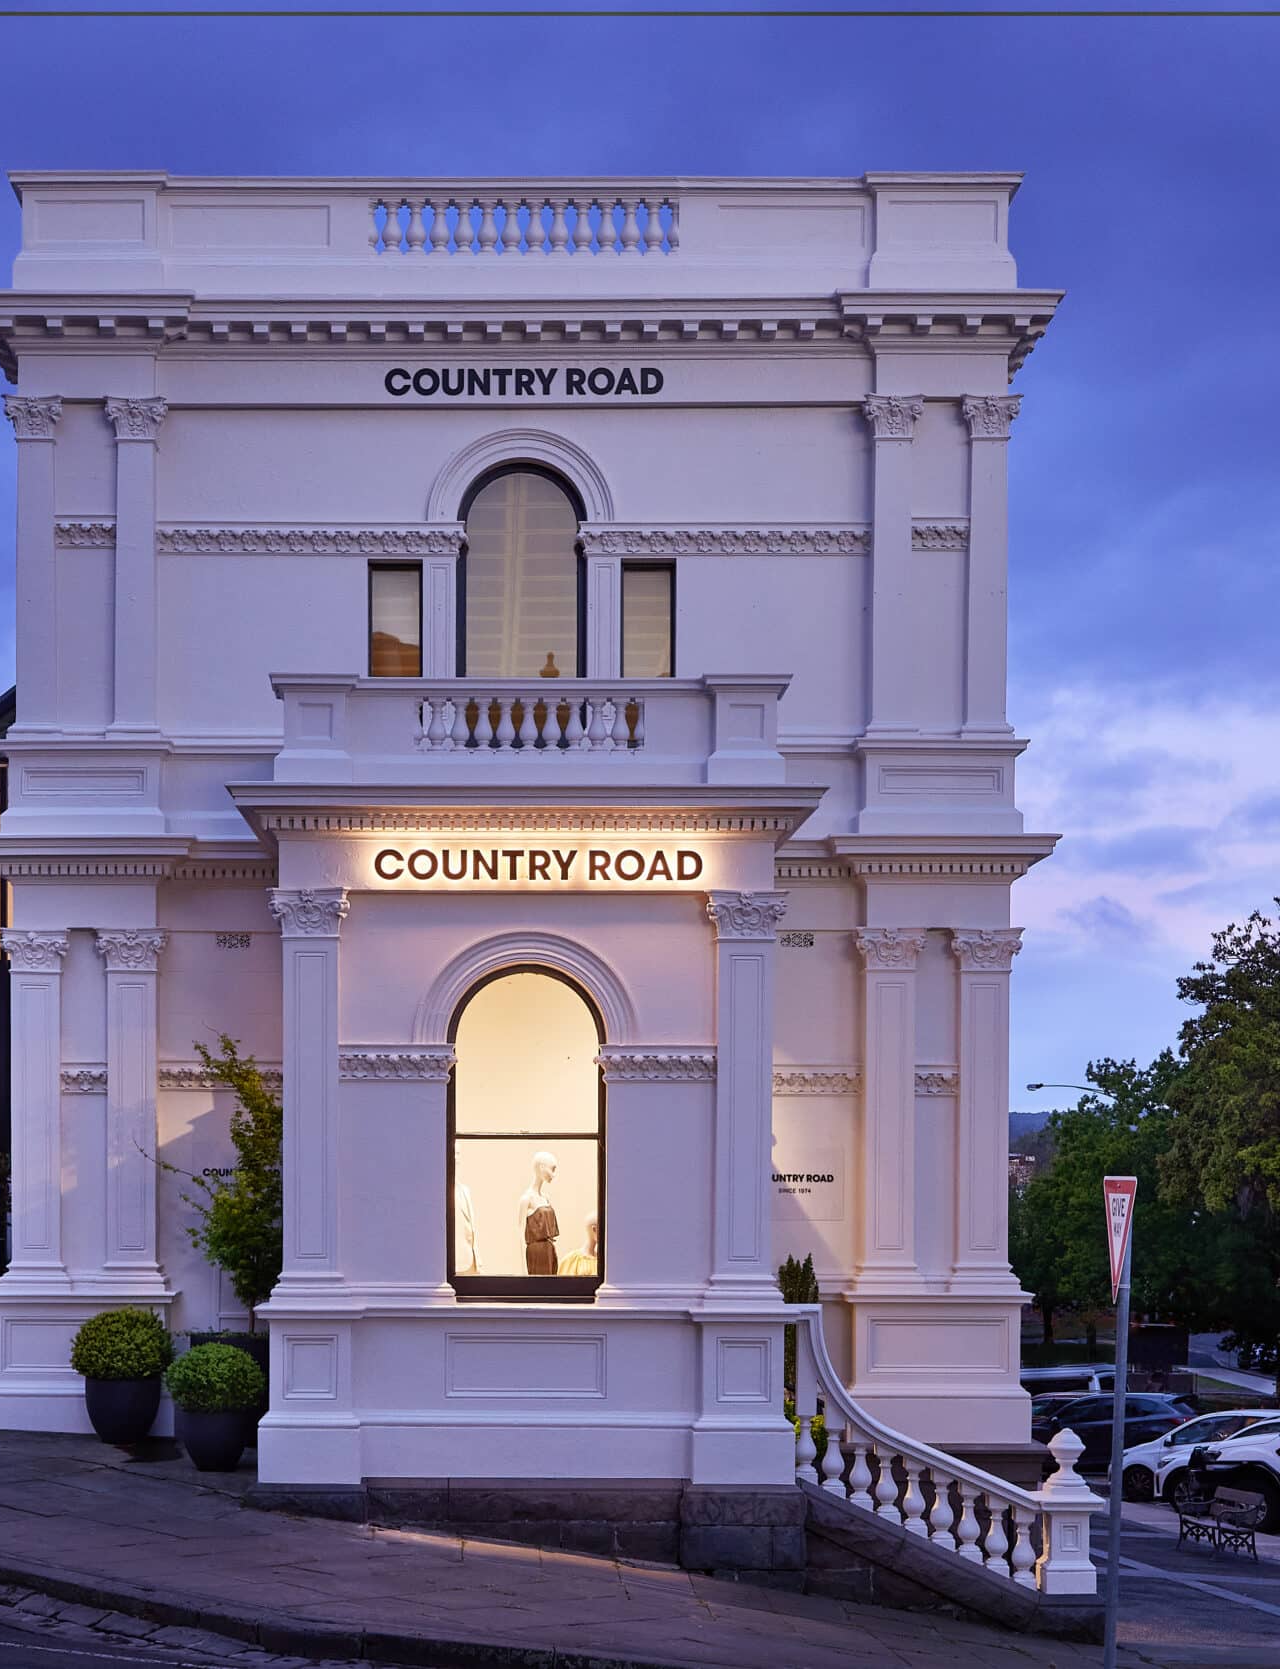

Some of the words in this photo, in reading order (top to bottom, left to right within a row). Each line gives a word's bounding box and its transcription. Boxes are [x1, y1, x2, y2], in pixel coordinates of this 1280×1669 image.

[384, 367, 559, 397] COUNTRY
[566, 367, 665, 397] ROAD
[374, 848, 578, 881] COUNTRY
[588, 849, 703, 881] ROAD
[771, 1173, 805, 1183] UNTRY
[806, 1173, 835, 1183] ROAD
[1111, 1197, 1126, 1217] GIVE
